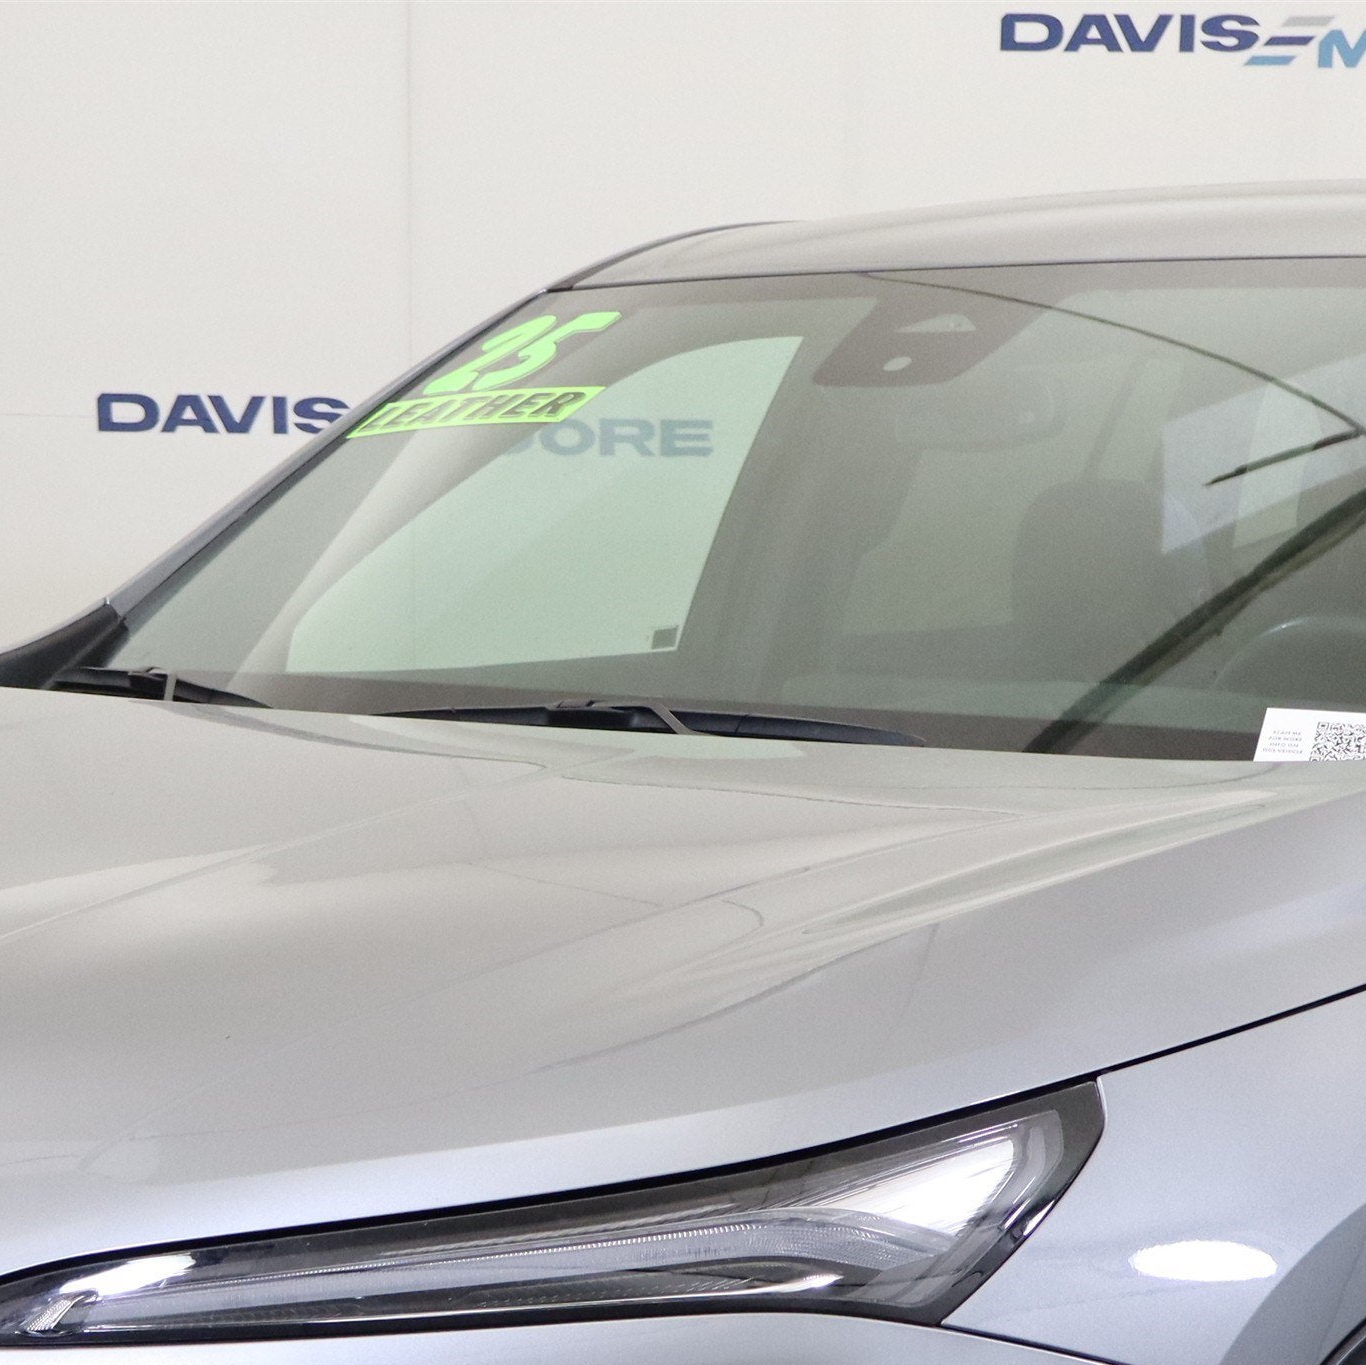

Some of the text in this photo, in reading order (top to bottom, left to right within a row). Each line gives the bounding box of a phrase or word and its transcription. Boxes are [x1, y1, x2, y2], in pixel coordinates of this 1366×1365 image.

[999, 12, 1261, 54] DAVIS
[423, 310, 622, 395] 25
[96, 392, 351, 435] DAVIS
[362, 390, 587, 434] LEATHER
